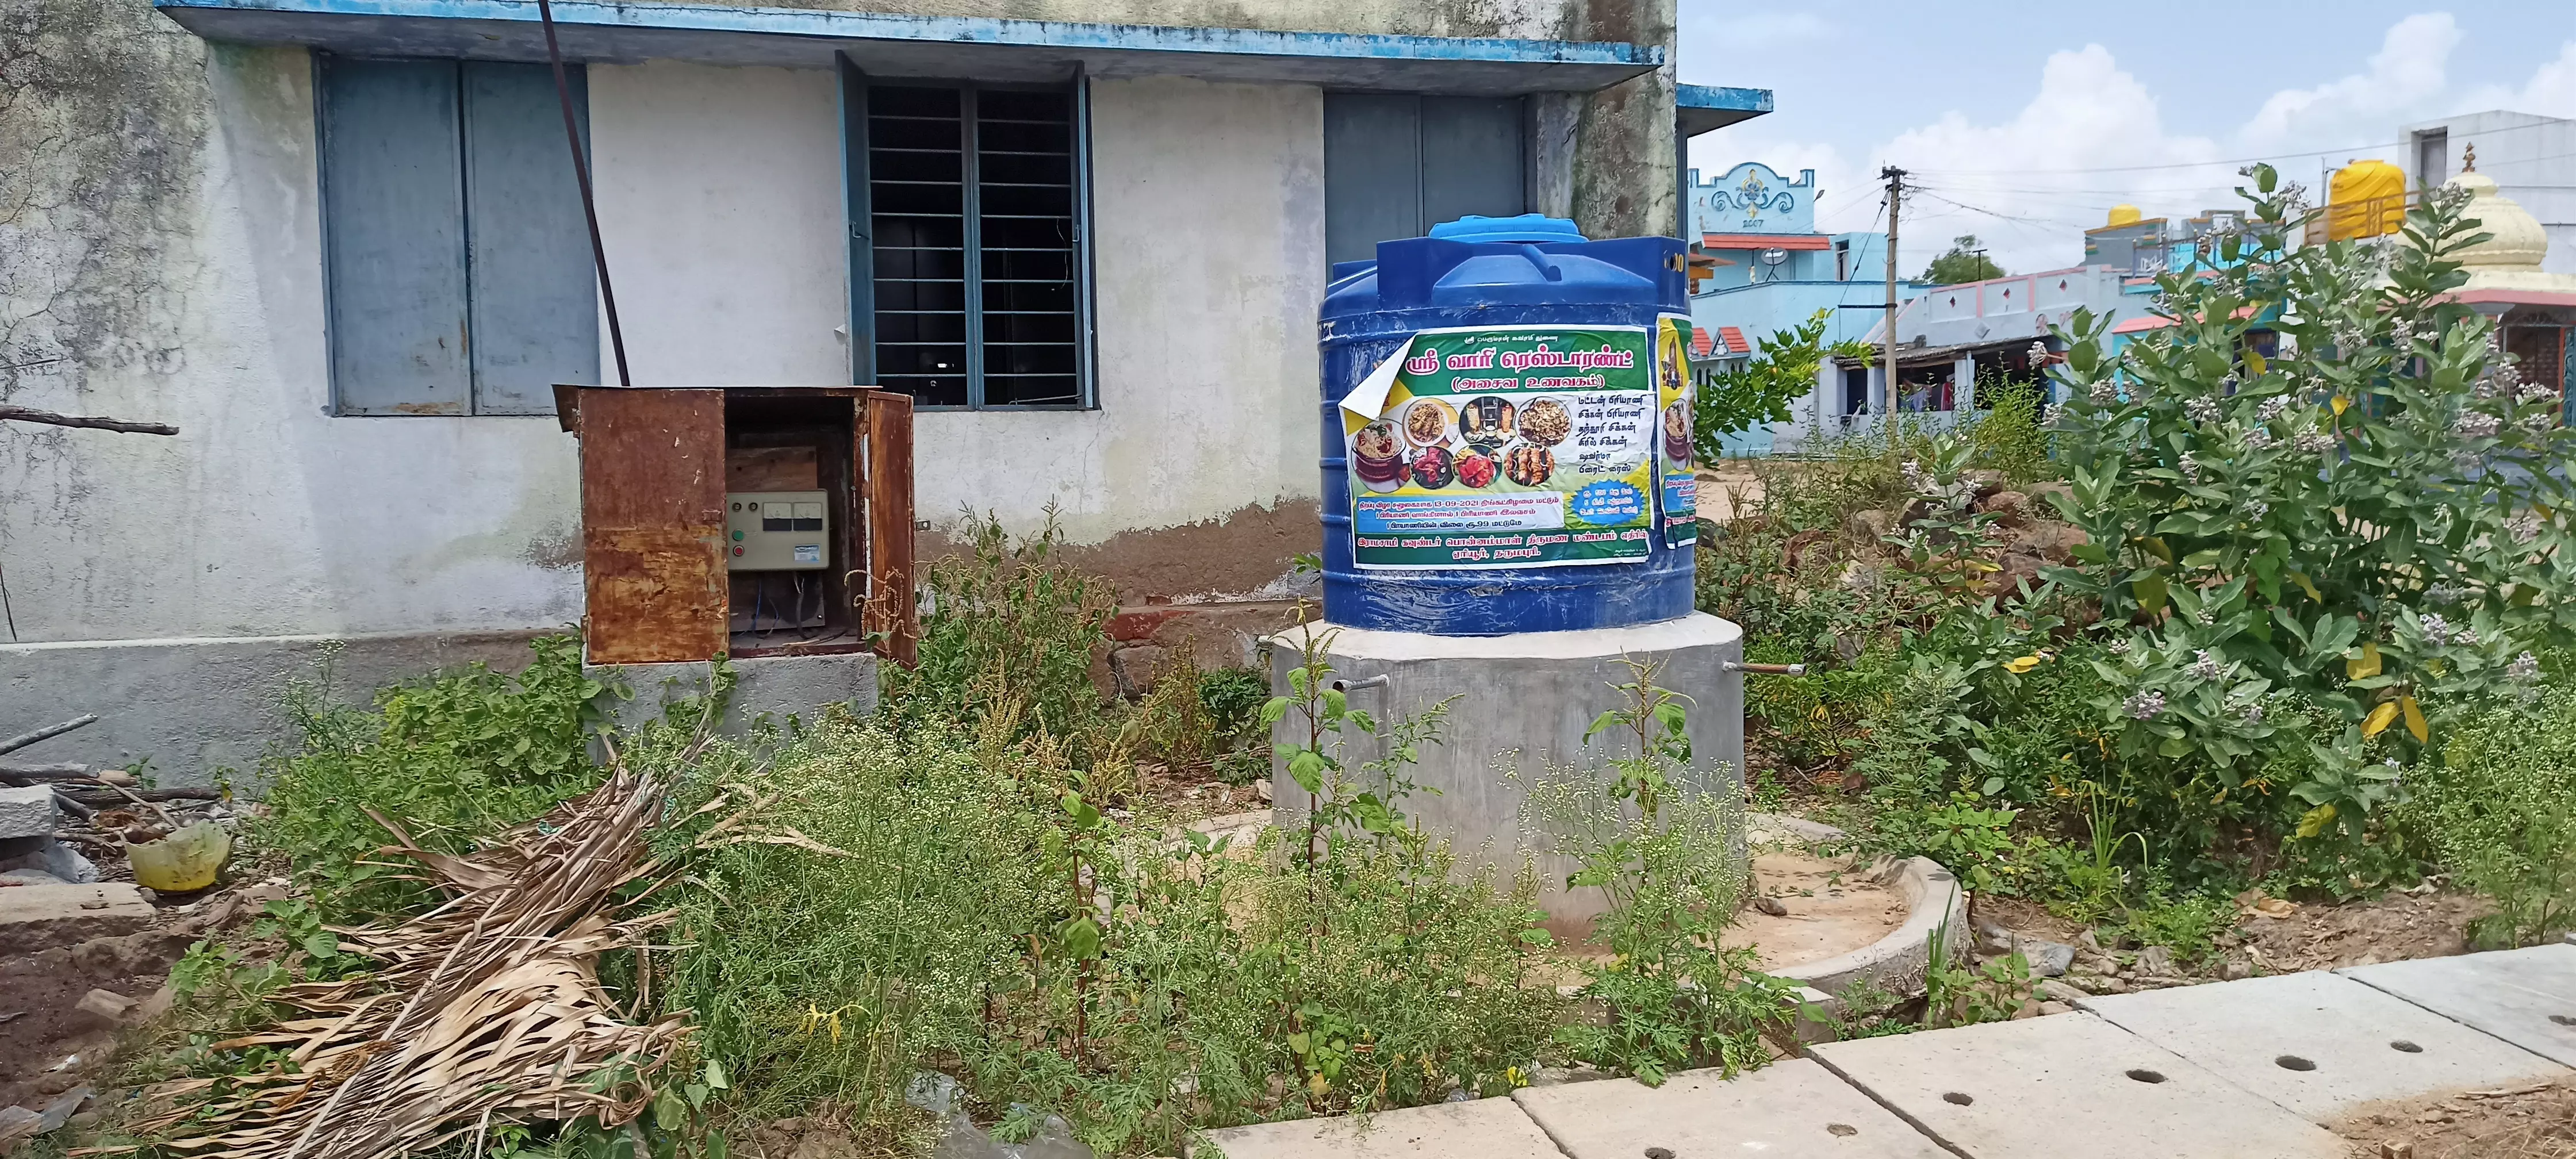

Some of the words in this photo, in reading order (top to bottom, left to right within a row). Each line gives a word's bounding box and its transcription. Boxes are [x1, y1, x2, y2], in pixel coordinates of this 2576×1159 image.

[1743, 219, 1764, 228] 2007
[1448, 350, 1494, 368] வாரி
[1502, 345, 1634, 373] ரெஸ்டாரண்ட்
[1452, 378, 1517, 392] (அசைவ
[1526, 375, 1605, 390] உணவகம்)
[1578, 395, 1605, 406] மட்டன்
[1609, 394, 1647, 405] பிரியாணி
[1578, 409, 1603, 420] சிக்கன்
[1607, 408, 1646, 419] பிரியாணி
[1608, 422, 1636, 433] சிக்கன்
[1600, 436, 1627, 447] சிக்கன்
[1434, 500, 1478, 508] 13-09-2021
[1536, 497, 1559, 505] மட்டும்
[1446, 535, 1522, 546] பொன்னம்மாள்
[1527, 534, 1568, 546] திருமண
